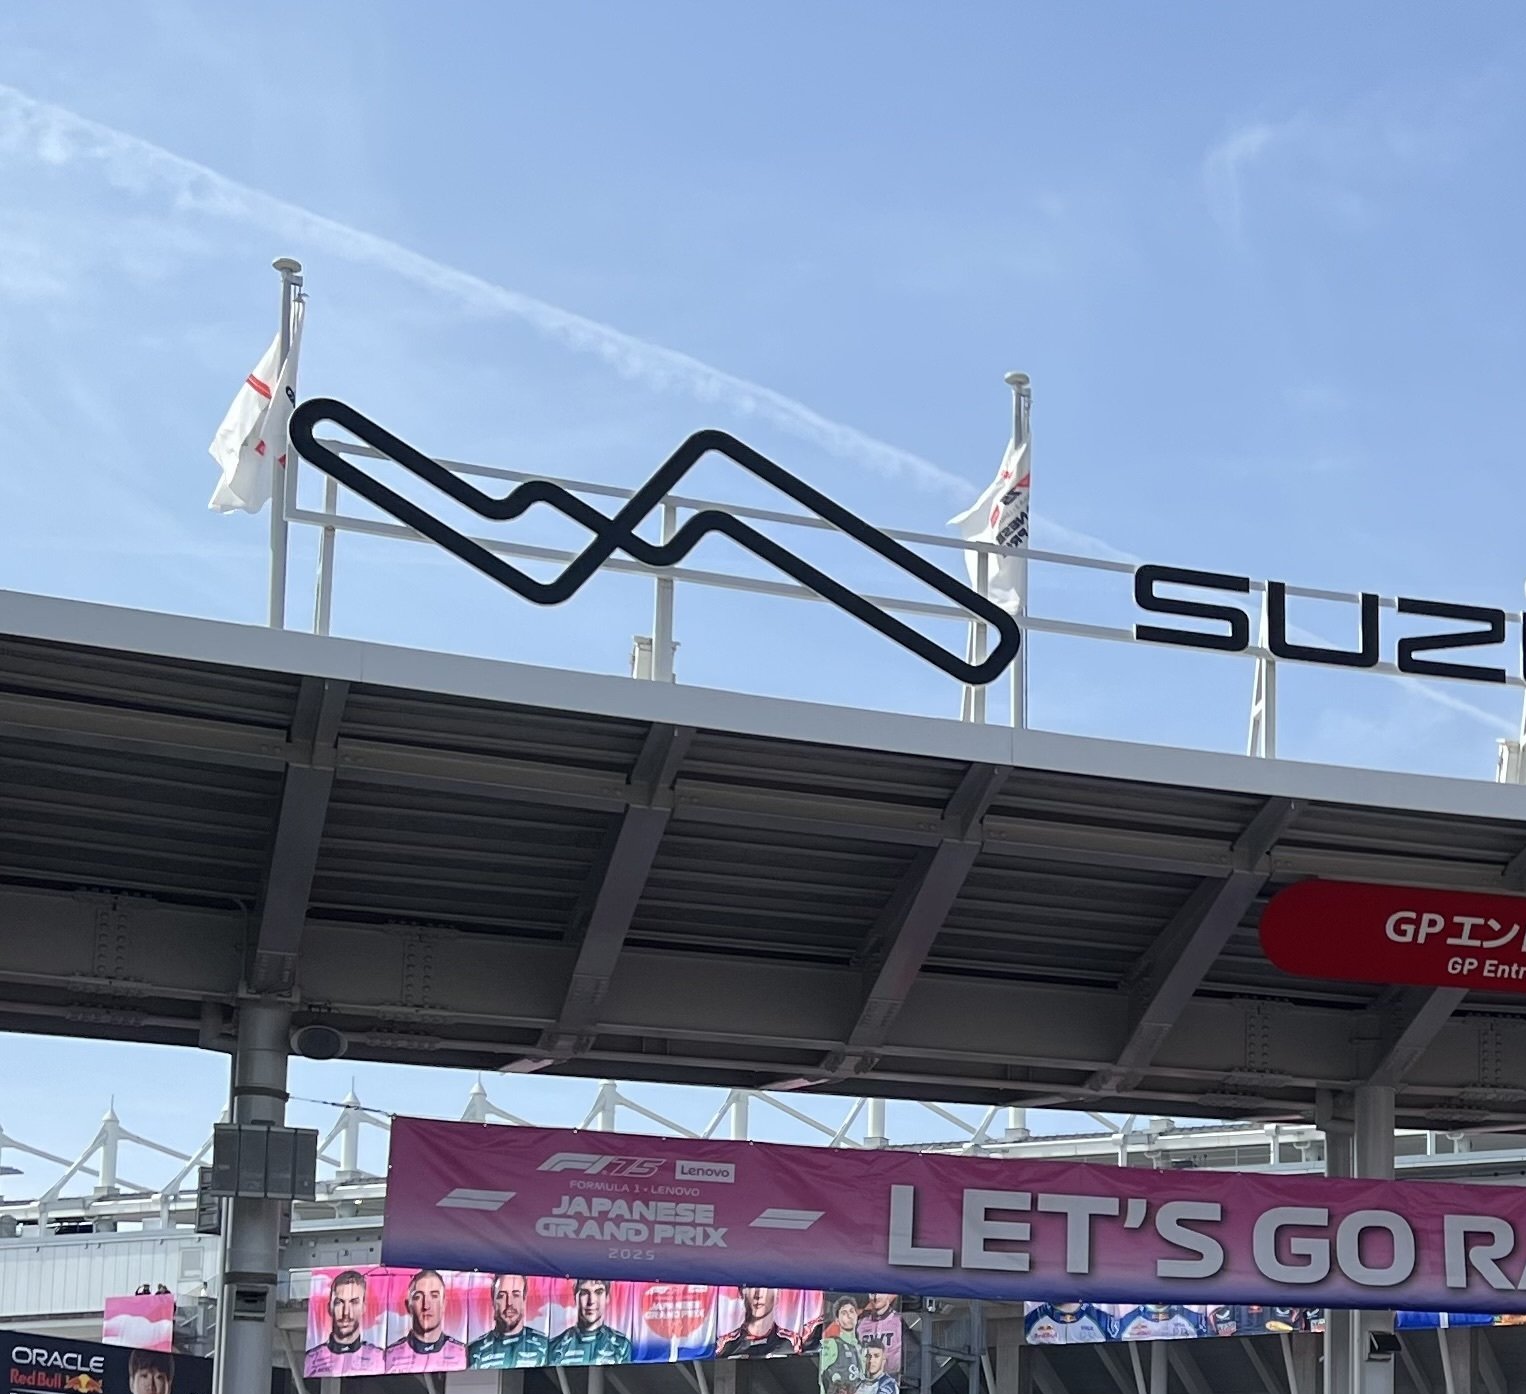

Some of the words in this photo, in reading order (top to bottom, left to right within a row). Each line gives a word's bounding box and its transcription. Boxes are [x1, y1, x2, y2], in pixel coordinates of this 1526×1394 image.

[1446, 956, 1478, 976] GP
[680, 1165, 730, 1178] Lenovo
[569, 1179, 630, 1193] FORMULA
[633, 1185, 640, 1193] 1
[651, 1187, 701, 1197] LENOVO
[552, 1196, 715, 1224] JAPANESE
[535, 1217, 650, 1243] GRAND
[653, 1225, 728, 1248] PRIX
[888, 1184, 1225, 1279] LET'S
[1252, 1206, 1417, 1287] GO
[608, 1248, 656, 1261] 2025
[11, 1346, 105, 1373] ORACLE
[10, 1368, 36, 1386] Red
[37, 1371, 62, 1389] Bull
